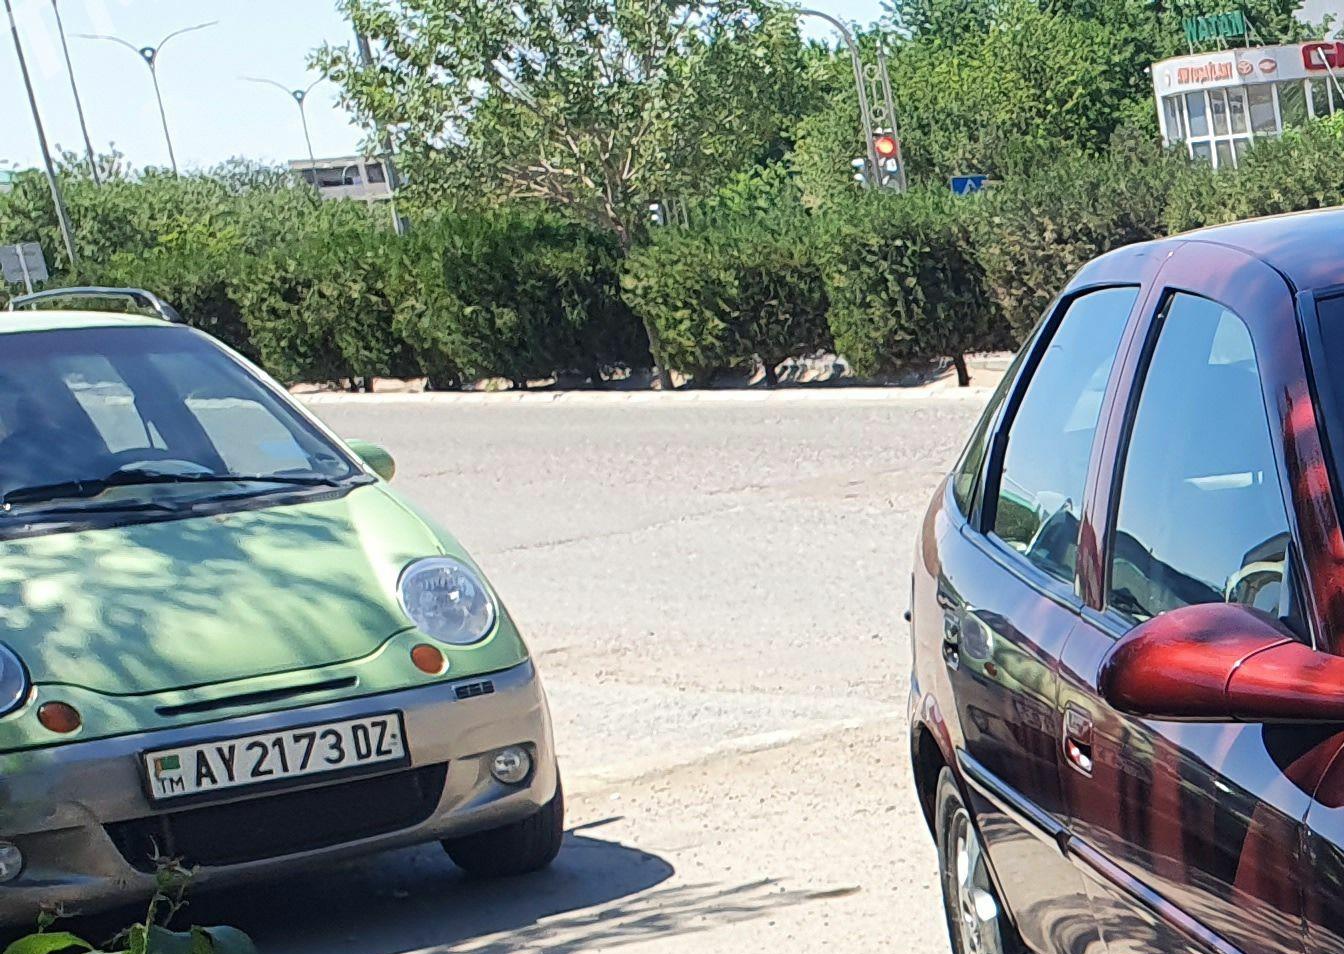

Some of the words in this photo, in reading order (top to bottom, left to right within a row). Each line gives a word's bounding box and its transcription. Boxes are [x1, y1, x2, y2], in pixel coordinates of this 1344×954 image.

[195, 743, 236, 787] AY
[246, 728, 345, 778] 2173
[352, 720, 391, 760] DZ
[158, 776, 186, 795] TM
